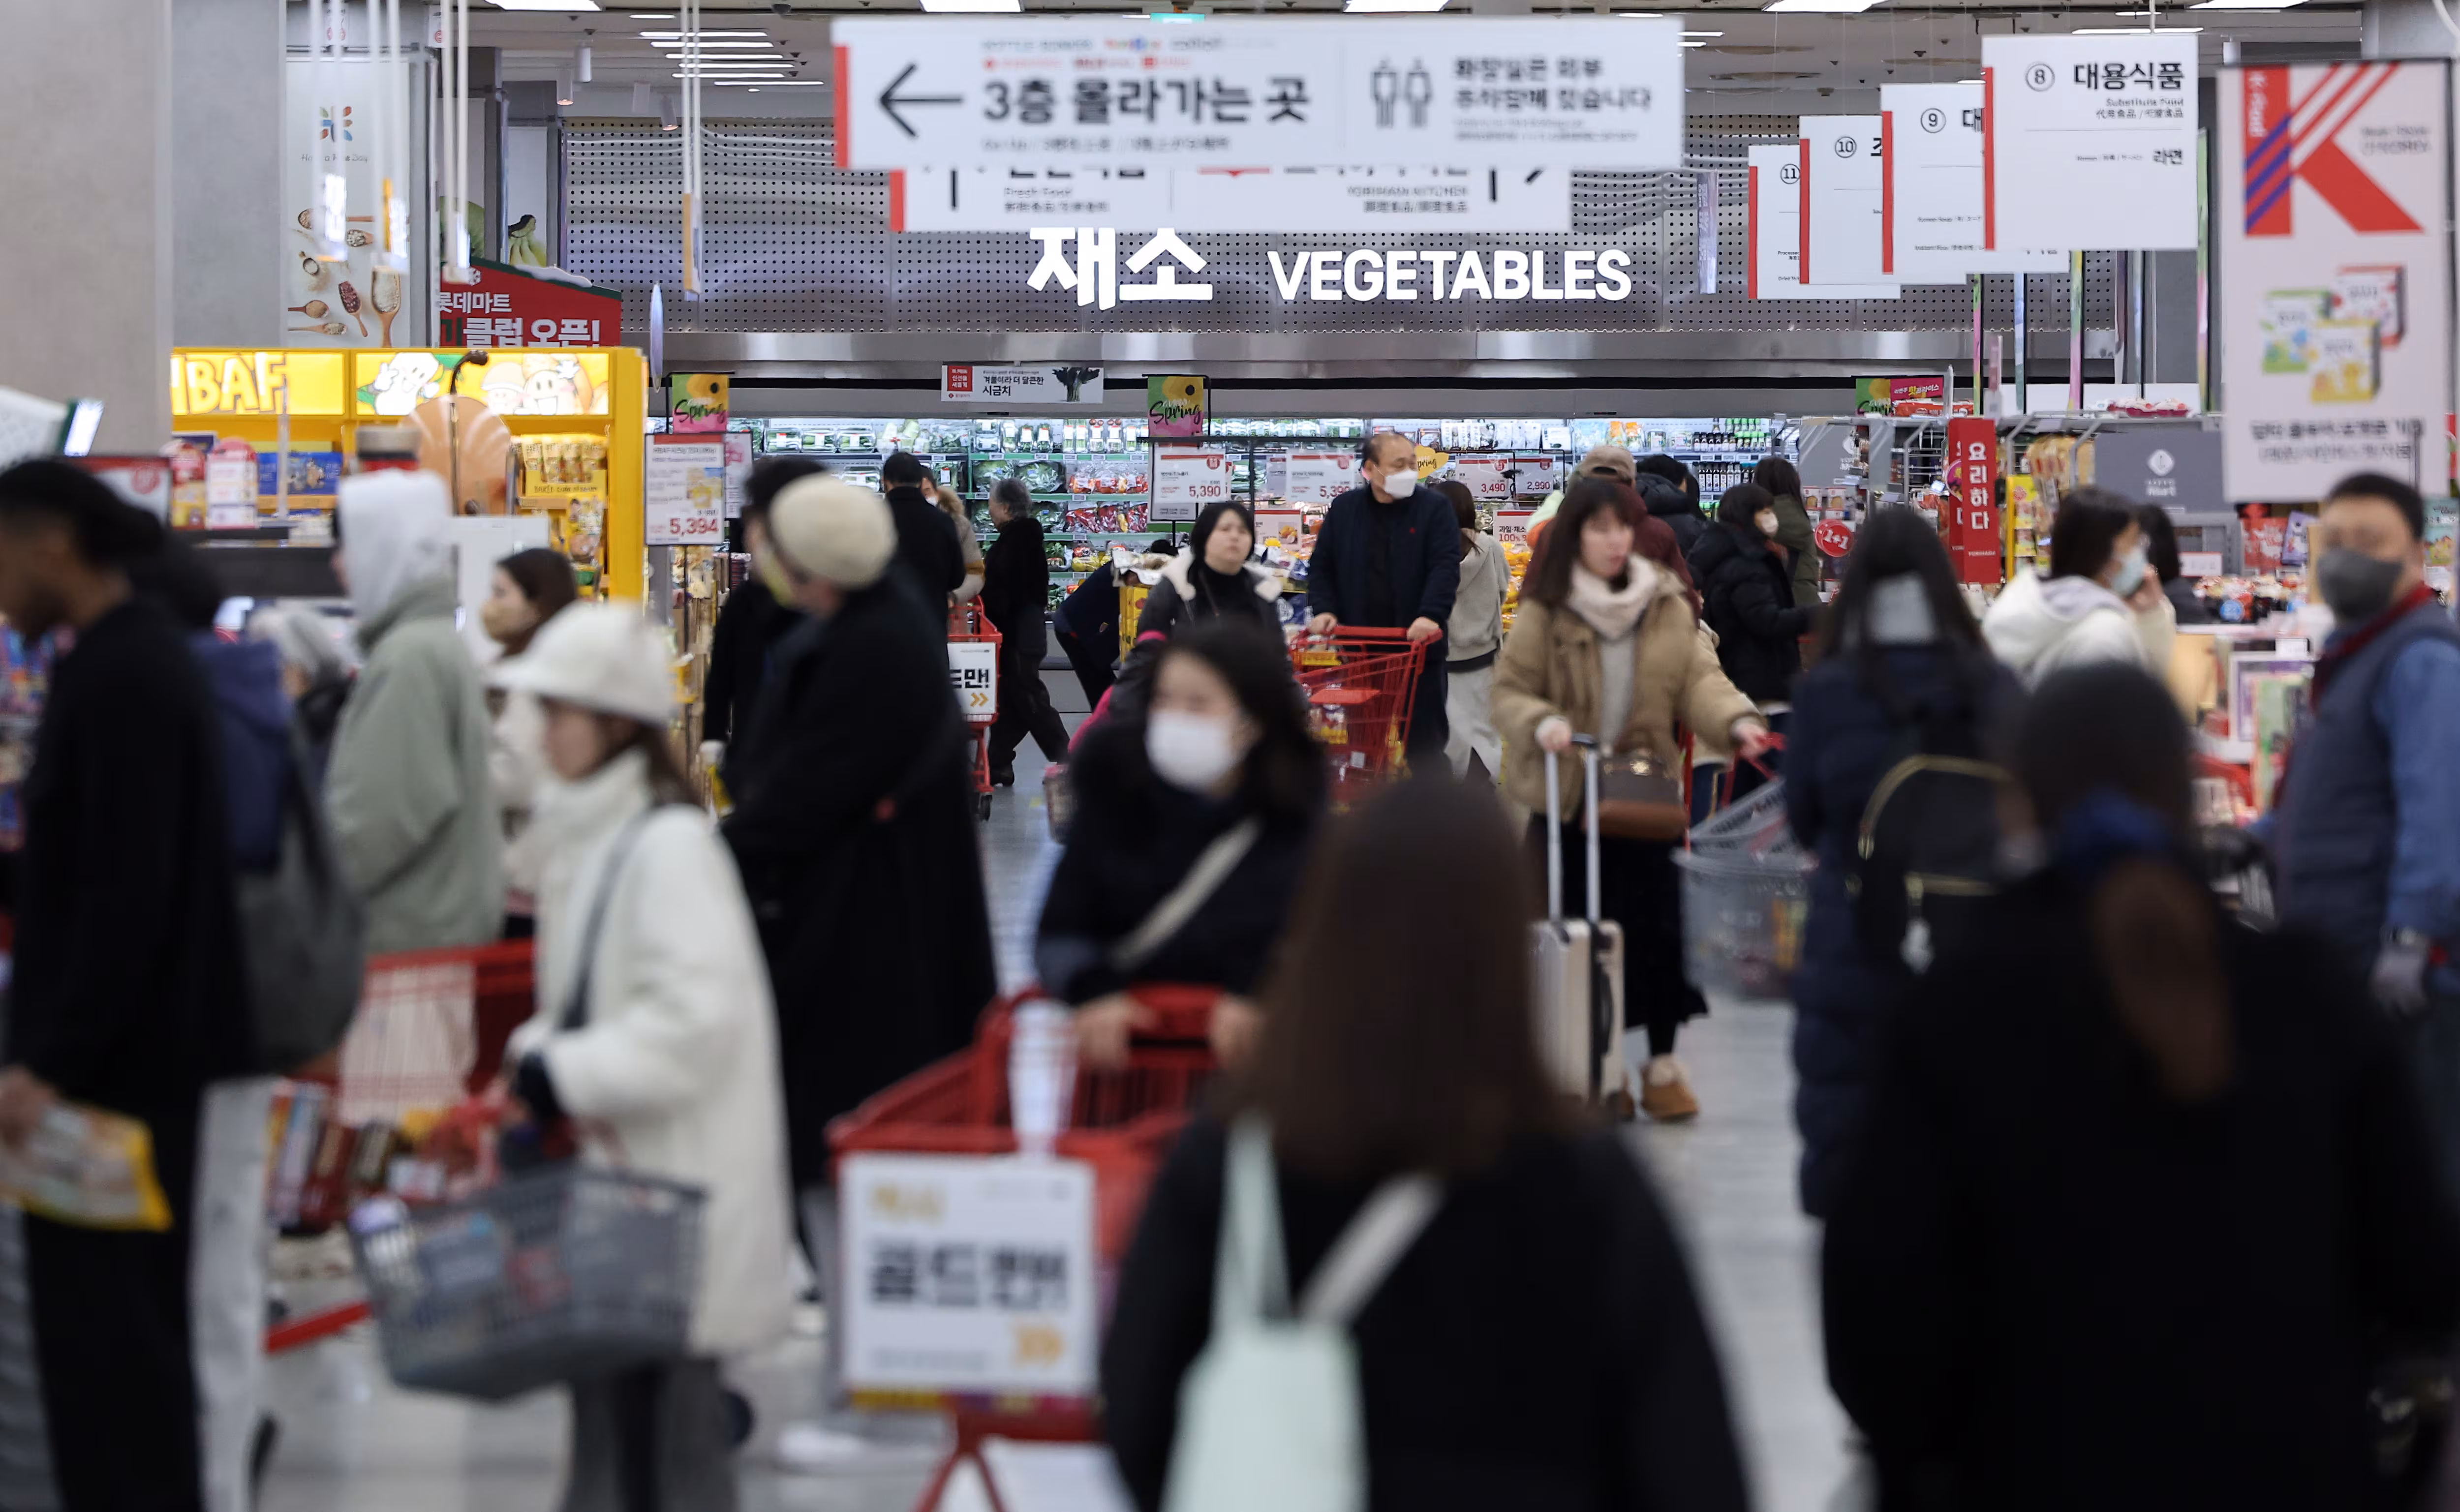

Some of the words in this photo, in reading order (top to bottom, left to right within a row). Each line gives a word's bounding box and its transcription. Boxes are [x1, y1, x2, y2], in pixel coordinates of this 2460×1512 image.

[2074, 62, 2184, 90] 대용식품
[984, 79, 1056, 124] 3층
[1266, 76, 1310, 123] 곳
[1267, 249, 1632, 301] VEGETABLES
[439, 292, 512, 313] 롯데마트
[463, 317, 523, 348] 클럽
[527, 319, 600, 348] 오픈!
[983, 385, 1011, 396] 시금치
[1149, 400, 1201, 425] Spring
[1416, 457, 1437, 470] pring
[1189, 485, 1221, 498] 5,390
[1481, 483, 1506, 493] 3,490
[1527, 481, 1550, 491] 2,990
[1968, 442, 1990, 529] 요리하다
